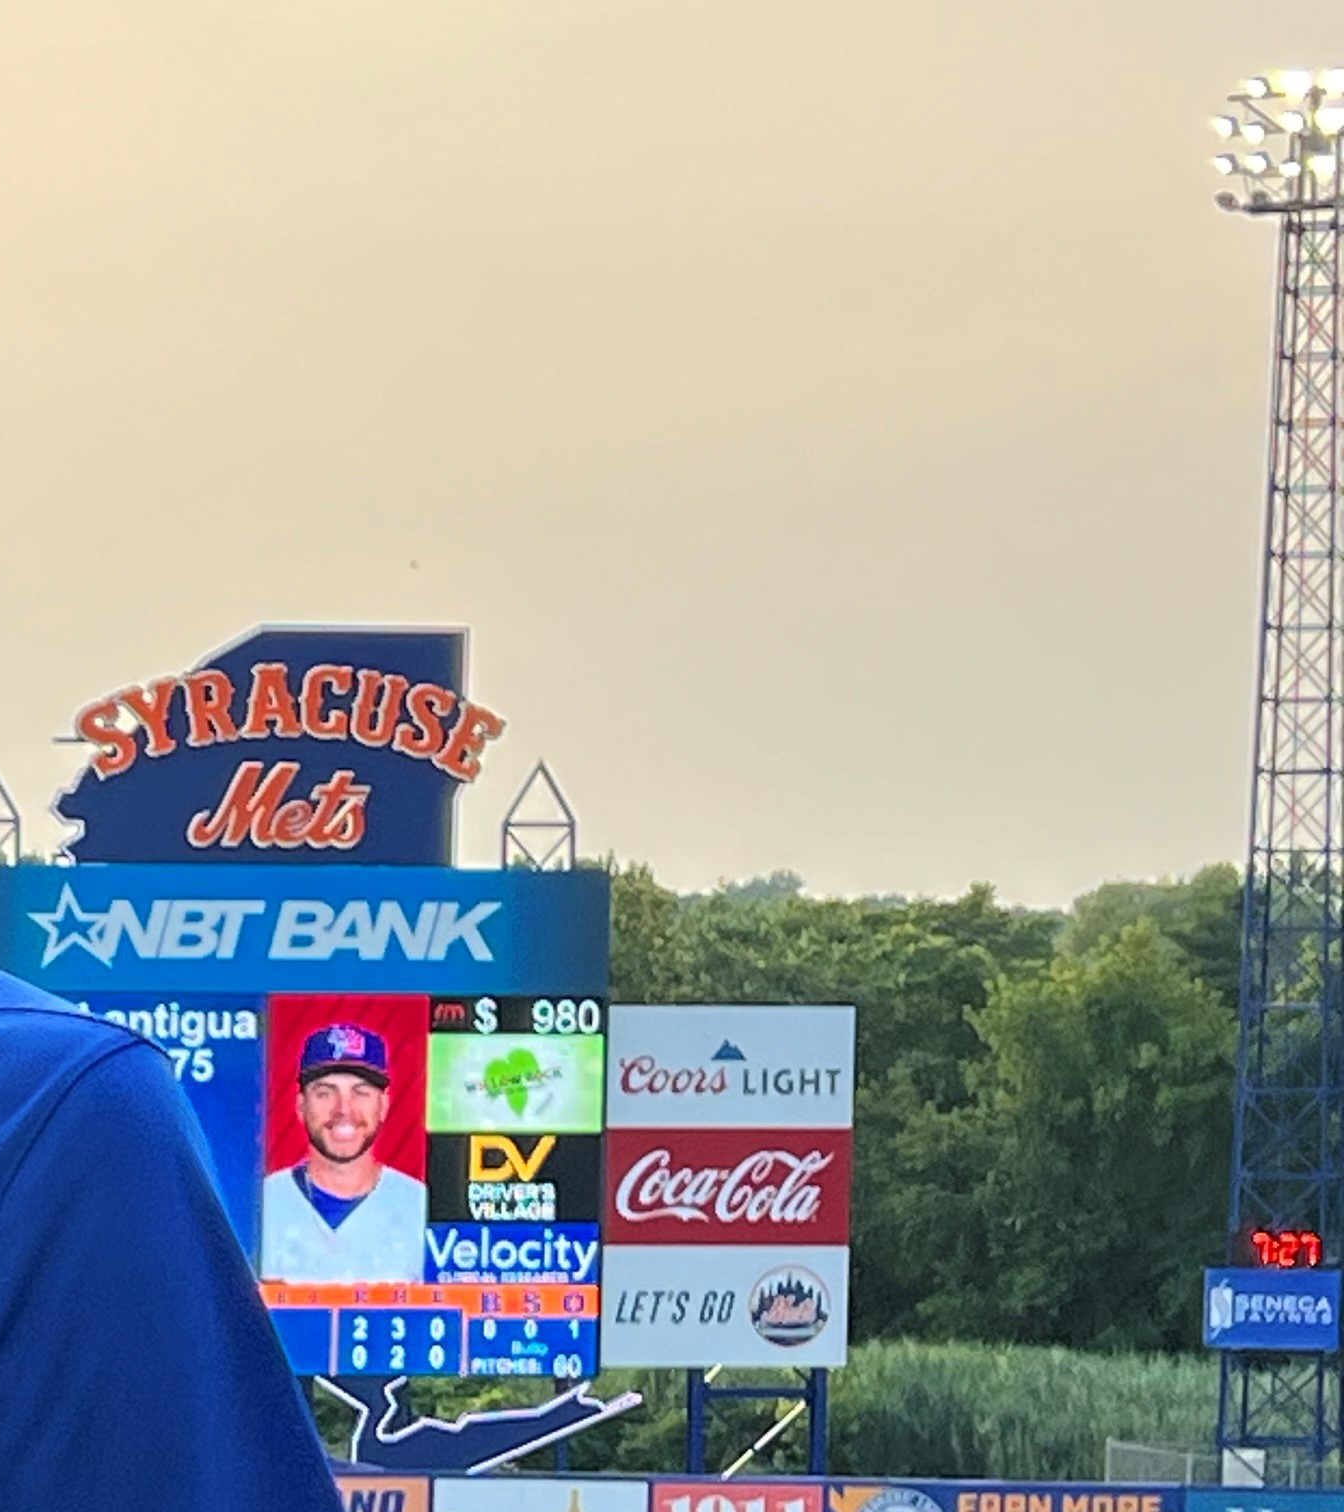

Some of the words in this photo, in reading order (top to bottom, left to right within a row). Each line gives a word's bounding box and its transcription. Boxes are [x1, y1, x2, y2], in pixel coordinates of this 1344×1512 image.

[75, 662, 507, 782] SYRACUSE
[186, 761, 372, 847] Mets
[106, 899, 265, 959] NBT
[267, 899, 502, 961] BANK
[473, 997, 498, 1034] $
[531, 999, 600, 1034] 980
[619, 1055, 728, 1095] Coors
[742, 1068, 842, 1095] LIGHT
[469, 1135, 556, 1181] DV
[615, 1149, 835, 1223] Coca-Cola
[469, 1202, 556, 1221] VILLAGE
[425, 1226, 598, 1281] Velocity
[1252, 1231, 1322, 1266] 7:27
[615, 1290, 691, 1325] LET'S
[699, 1290, 736, 1325] GO
[1235, 1295, 1332, 1312] SENECA
[353, 1316, 367, 1340] 2
[391, 1316, 406, 1340] 3
[429, 1316, 445, 1341] 0
[568, 1318, 580, 1340] 1
[351, 1345, 367, 1369] 0
[390, 1345, 405, 1369] 2
[429, 1345, 445, 1369] 0
